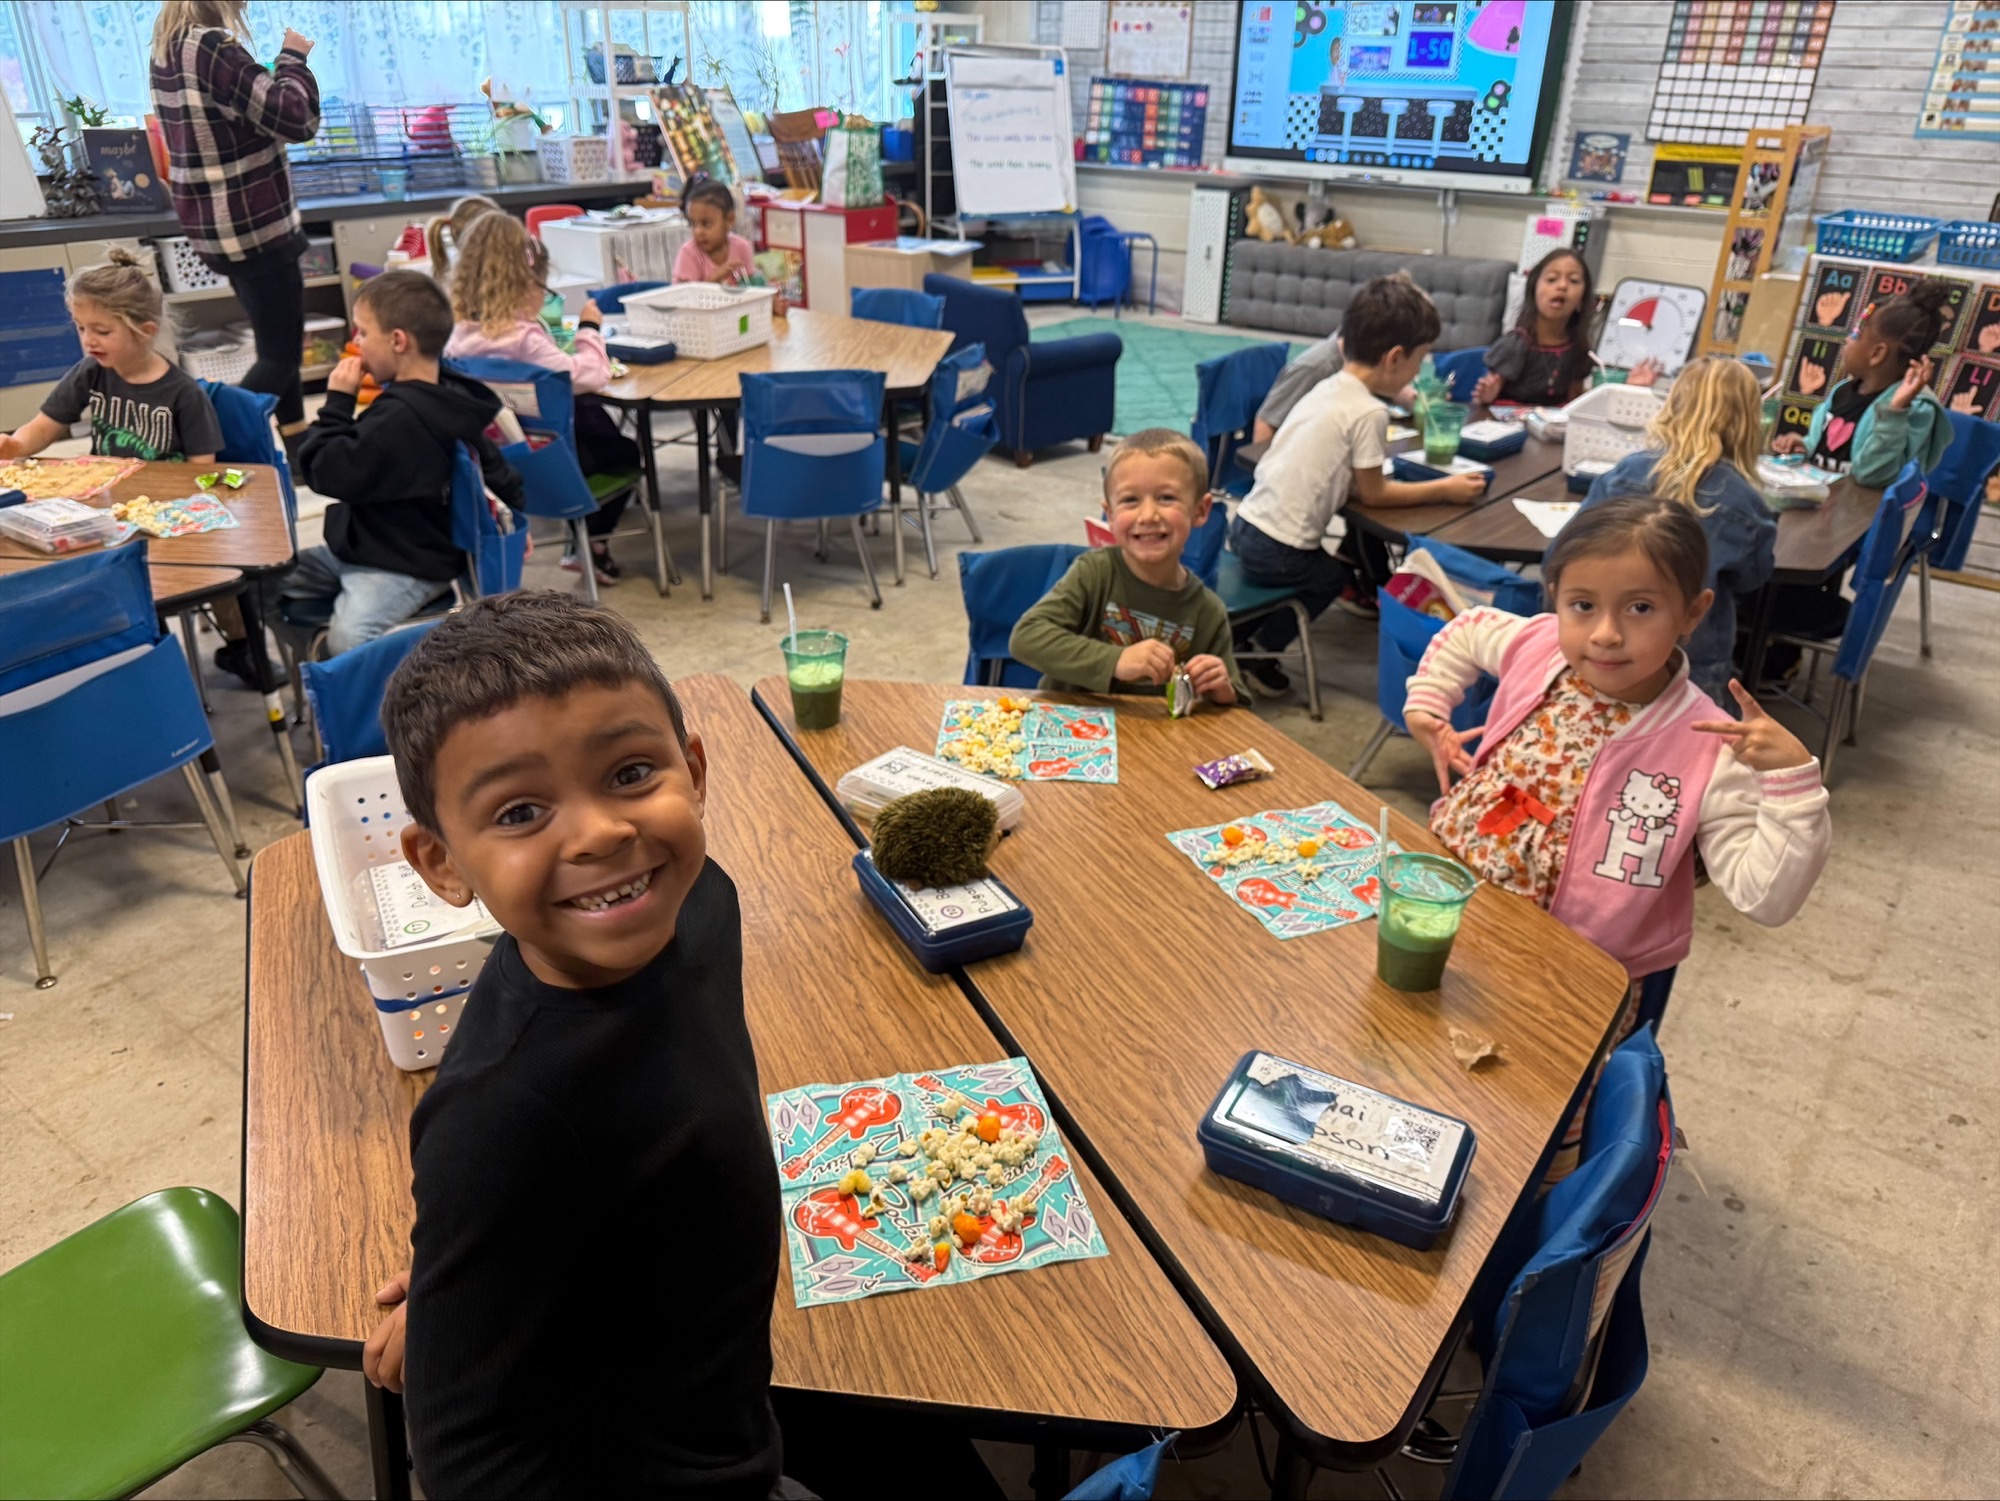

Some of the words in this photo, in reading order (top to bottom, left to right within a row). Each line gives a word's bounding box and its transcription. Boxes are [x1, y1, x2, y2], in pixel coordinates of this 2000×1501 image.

[1408, 38, 1453, 61] 1-50
[1824, 269, 1854, 289] Aa
[1878, 275, 1908, 296] Bb
[1949, 290, 1962, 304] c
